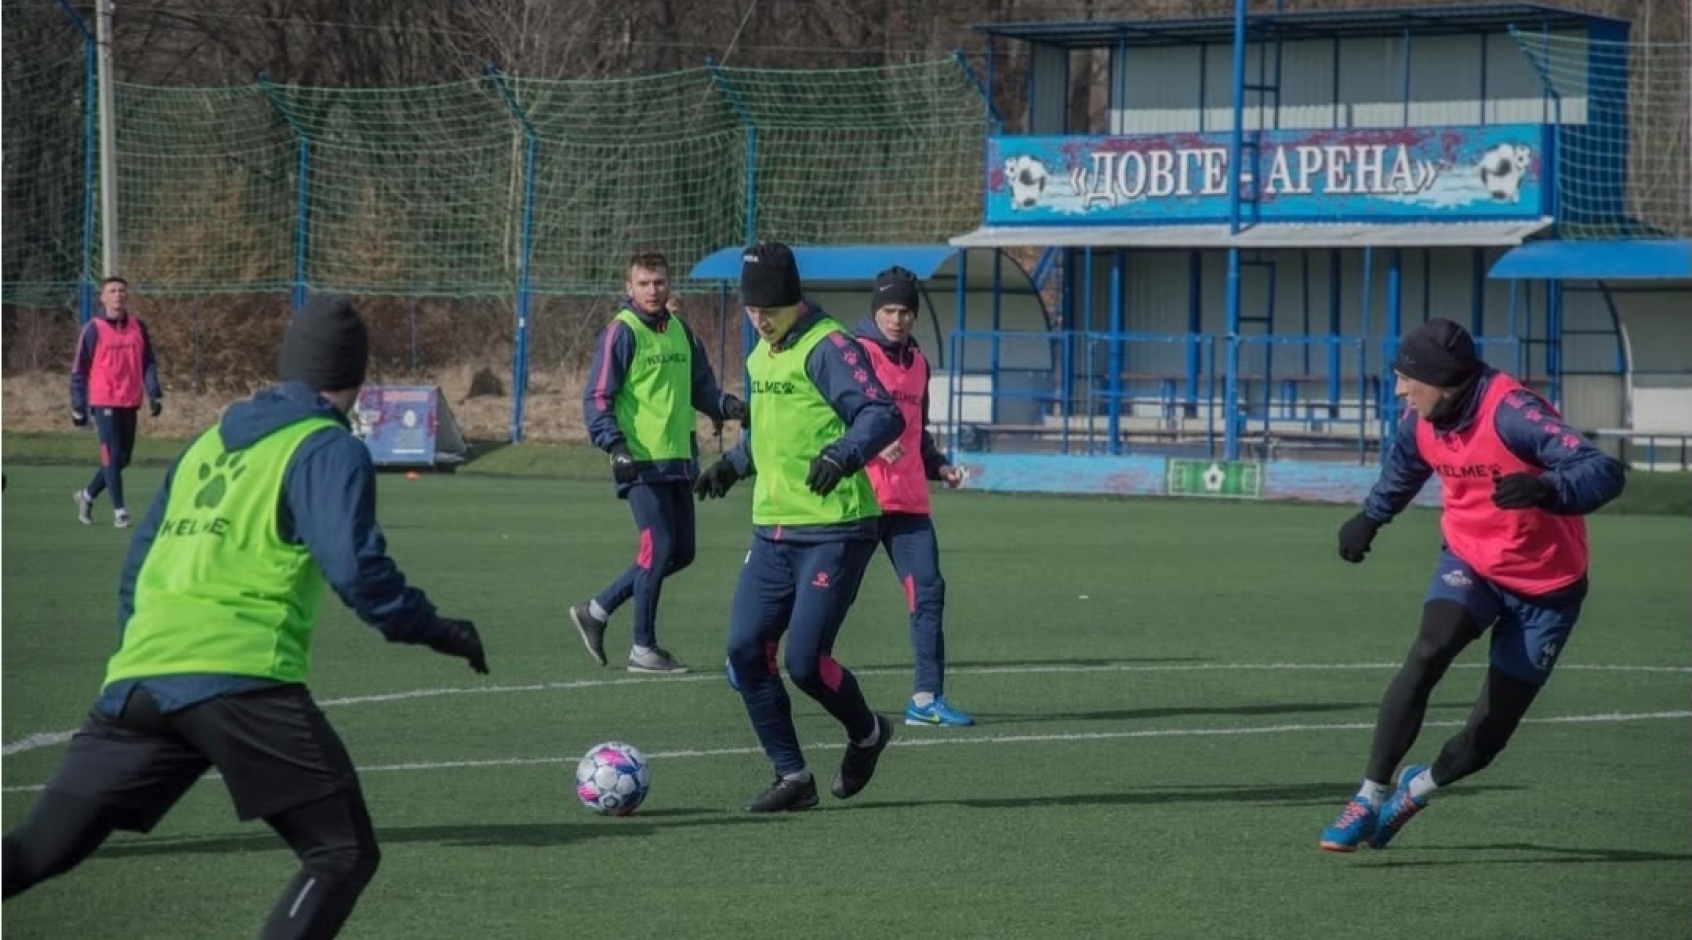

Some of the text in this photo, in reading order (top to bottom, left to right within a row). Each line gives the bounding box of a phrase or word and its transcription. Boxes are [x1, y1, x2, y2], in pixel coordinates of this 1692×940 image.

[1070, 148, 1229, 208] «ДОВГЕ
[1265, 143, 1438, 194] АРЕНА»
[751, 380, 782, 394] ELME
